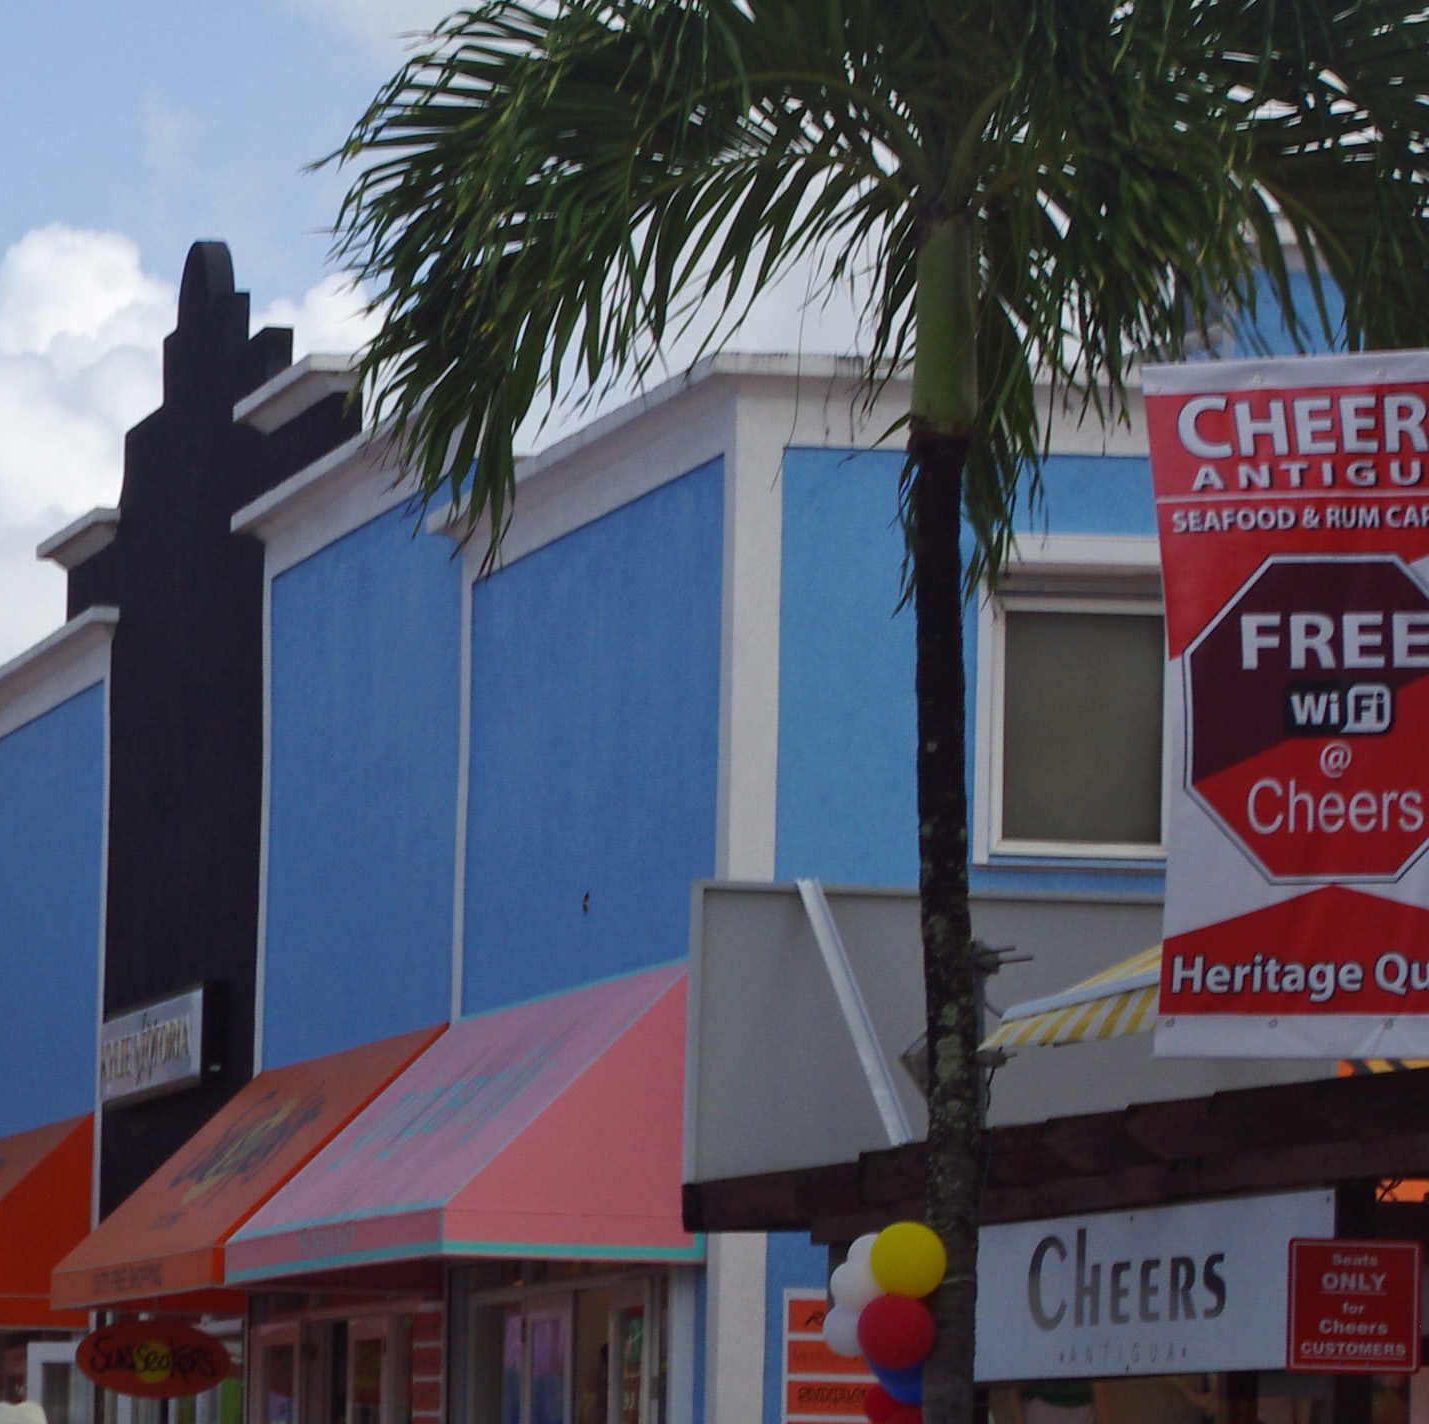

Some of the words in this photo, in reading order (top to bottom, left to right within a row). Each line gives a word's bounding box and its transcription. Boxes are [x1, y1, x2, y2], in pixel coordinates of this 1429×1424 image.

[1177, 394, 1429, 459] CHEER
[1191, 460, 1423, 492] ANTIGU
[1172, 507, 1296, 533] SEAFOOD
[1302, 507, 1321, 529] &
[1326, 506, 1380, 529] RUM
[1240, 611, 1429, 670] FREE
[1319, 741, 1353, 778] @
[1246, 778, 1425, 835] Cheers
[1170, 953, 1364, 1003] Heritage
[1374, 951, 1429, 997] Qu
[1332, 1253, 1378, 1266] Seats
[1322, 1272, 1388, 1291] ONLY
[1342, 1302, 1365, 1314] for
[1319, 1319, 1388, 1335] Cheers
[1067, 1340, 1177, 1365] ANTIGUA
[1300, 1340, 1406, 1357] CUSTOMERS
